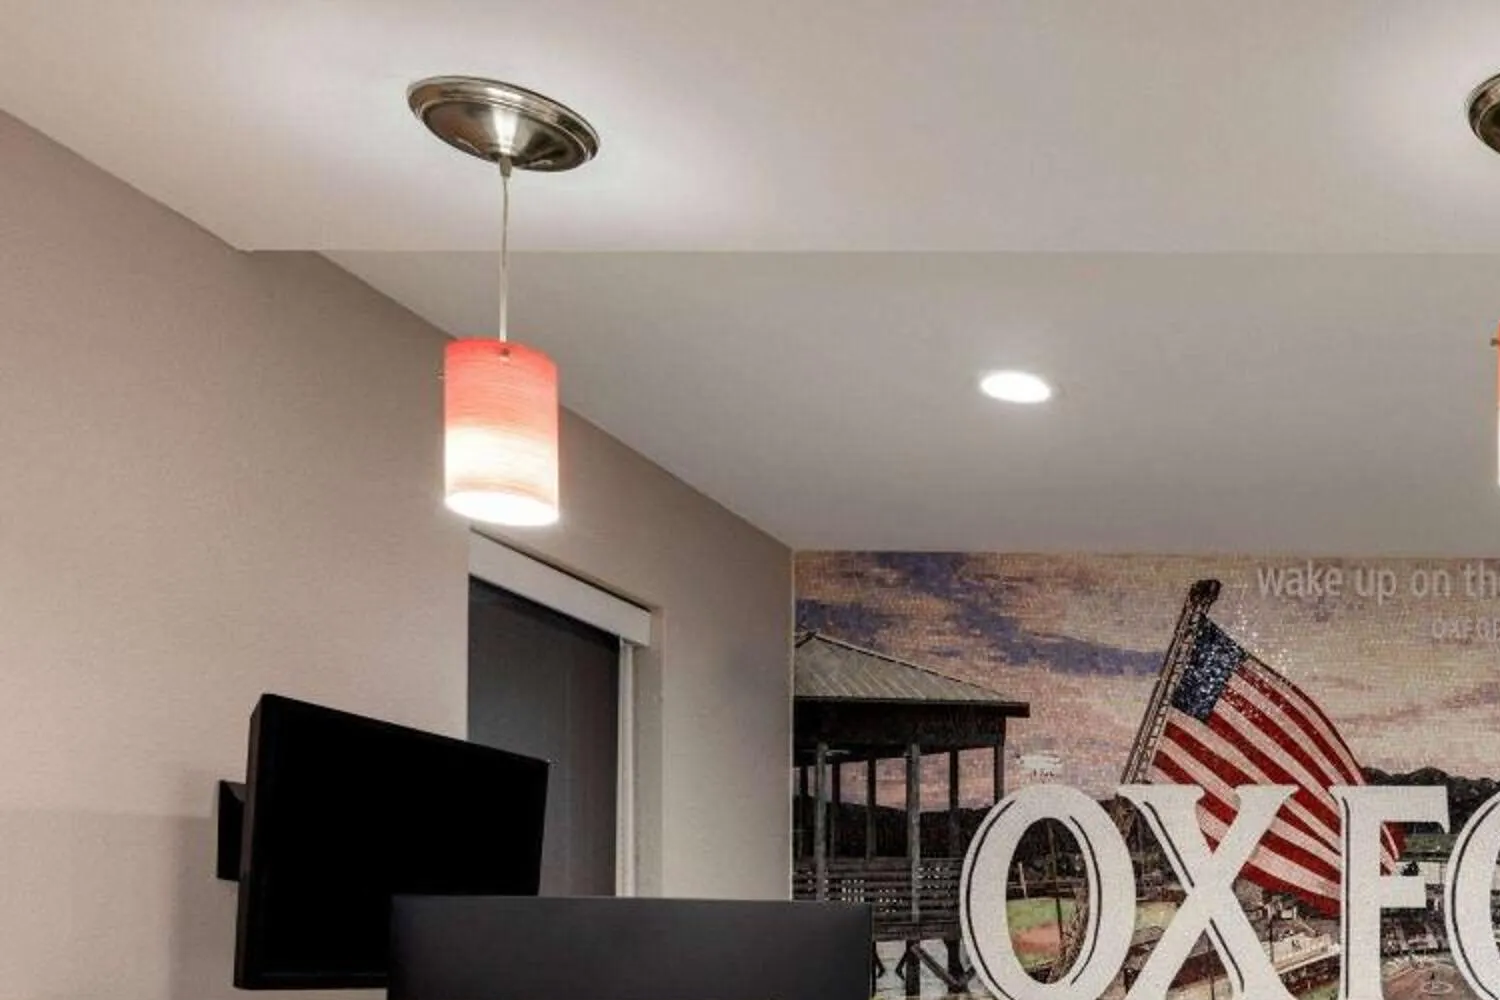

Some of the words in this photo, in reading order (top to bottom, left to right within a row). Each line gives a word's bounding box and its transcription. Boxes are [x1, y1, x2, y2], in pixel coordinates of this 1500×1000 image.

[1257, 559, 1343, 598] wake
[1356, 566, 1398, 606] up
[1411, 567, 1451, 598] on
